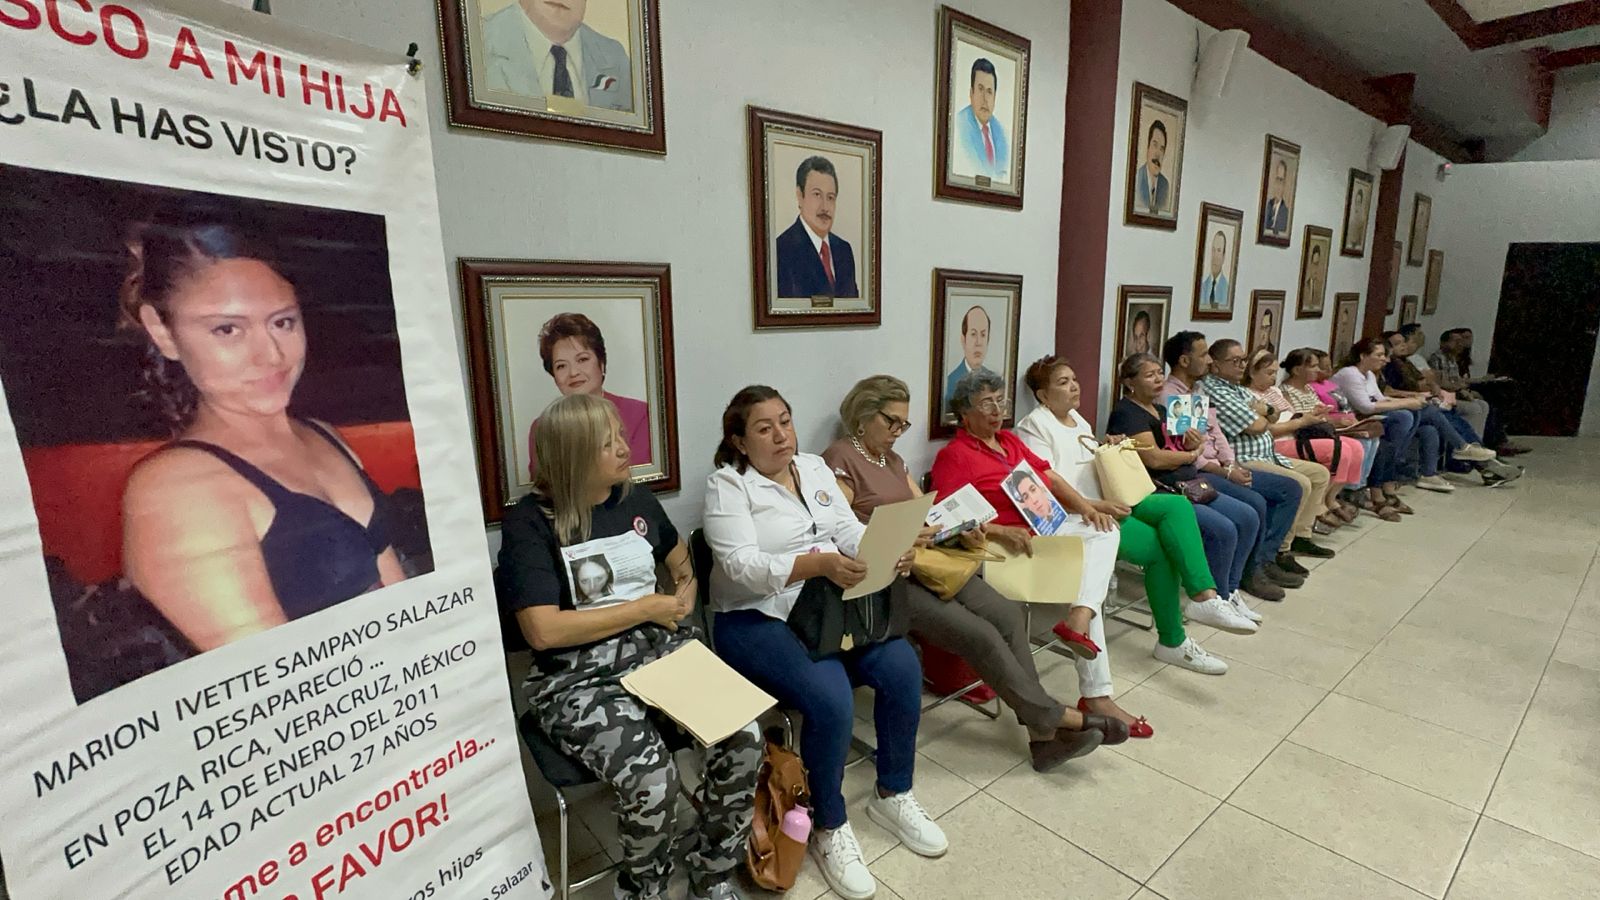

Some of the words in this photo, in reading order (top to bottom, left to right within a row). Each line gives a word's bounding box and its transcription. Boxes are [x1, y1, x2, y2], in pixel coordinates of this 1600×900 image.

[169, 26, 214, 80] A
[224, 40, 285, 98] MI
[300, 64, 407, 128] HIJA
[110, 97, 213, 149] HAS
[221, 121, 357, 175] VISTO?
[33, 711, 160, 798] MARION
[175, 664, 270, 721] IVETTE
[275, 620, 382, 679] SAMPAYO
[386, 587, 475, 632] SALAZAR
[193, 654, 364, 751] DESAPARECIÓ
[64, 824, 109, 869] EN
[114, 774, 195, 837] POZA
[201, 738, 272, 784] RICA,
[274, 674, 398, 744] VERACRUZ,
[402, 640, 476, 684] MÉXICO
[143, 828, 176, 860] EL
[181, 800, 214, 831] 14
[220, 774, 258, 810] DE
[264, 731, 345, 786] ENERO
[350, 709, 390, 740] DEL
[393, 684, 439, 717] 2011
[165, 822, 241, 885] EDAD
[250, 764, 347, 831] ACTUAL
[350, 745, 375, 772] 27
[383, 712, 437, 756] AÑOS
[288, 841, 307, 866] a
[316, 738, 496, 847] encontrarla...
[311, 793, 449, 900] FAVOR!
[439, 847, 483, 887] hijos
[491, 861, 533, 900] Salazar
